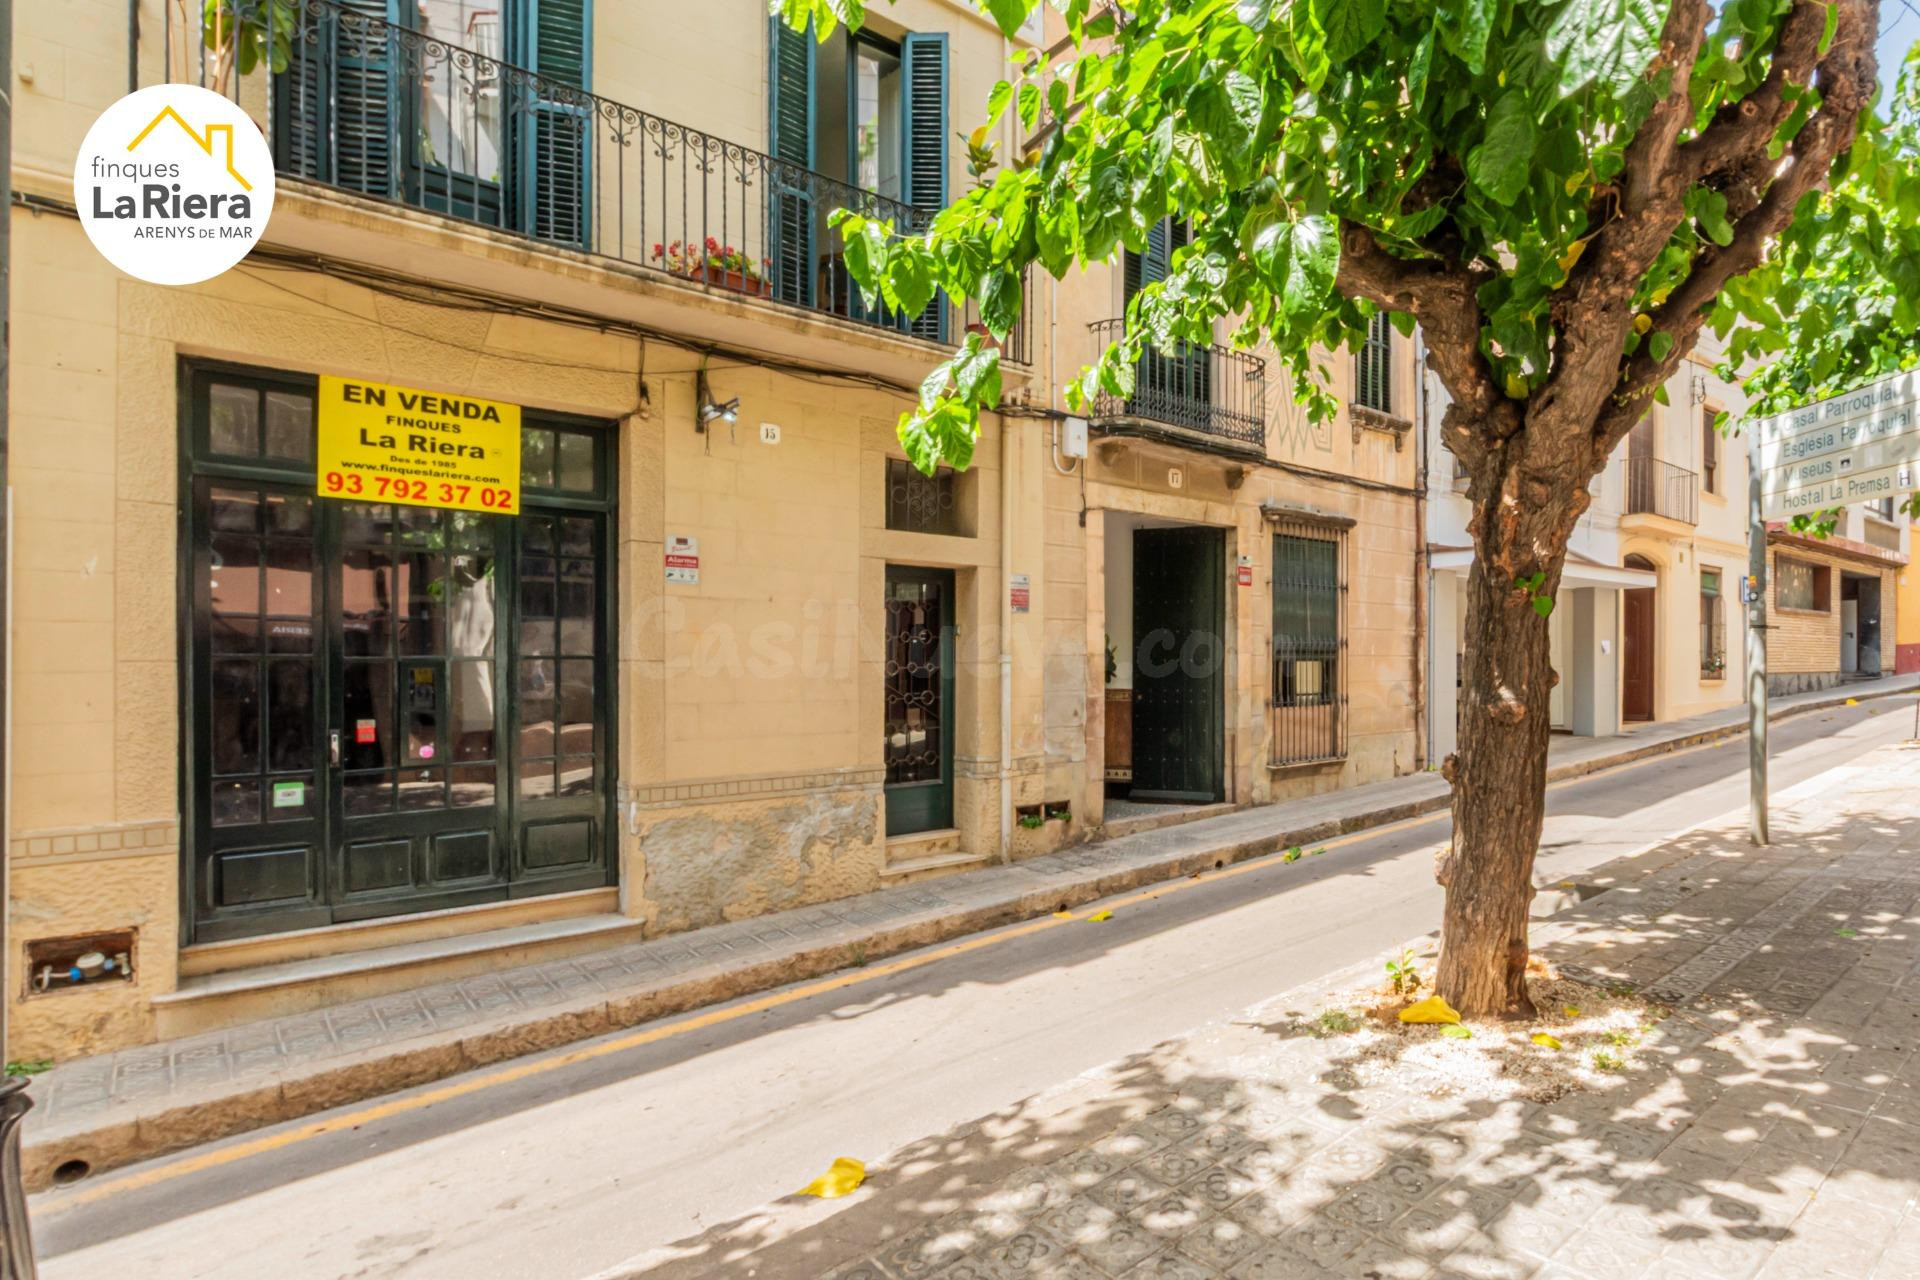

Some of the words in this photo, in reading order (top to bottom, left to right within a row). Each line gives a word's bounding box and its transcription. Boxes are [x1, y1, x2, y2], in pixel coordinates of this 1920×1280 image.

[343, 384, 386, 407] EN
[398, 392, 501, 423] VENDA
[386, 415, 462, 433] FINQUES
[1783, 407, 1818, 431] Casal
[359, 428, 396, 449] La
[408, 434, 485, 459] Riera
[765, 427, 776, 440] 15
[390, 455, 411, 465] Des
[414, 457, 427, 466] de
[1783, 460, 1833, 483] Museus
[341, 461, 500, 484] www.finqueslariera.com
[326, 471, 363, 494] 93
[374, 476, 428, 500] 792
[438, 483, 471, 504] 37
[481, 488, 512, 509] 02
[1783, 491, 1824, 510] Hostal
[1830, 484, 1843, 500] La
[1848, 477, 1890, 496] Premsa
